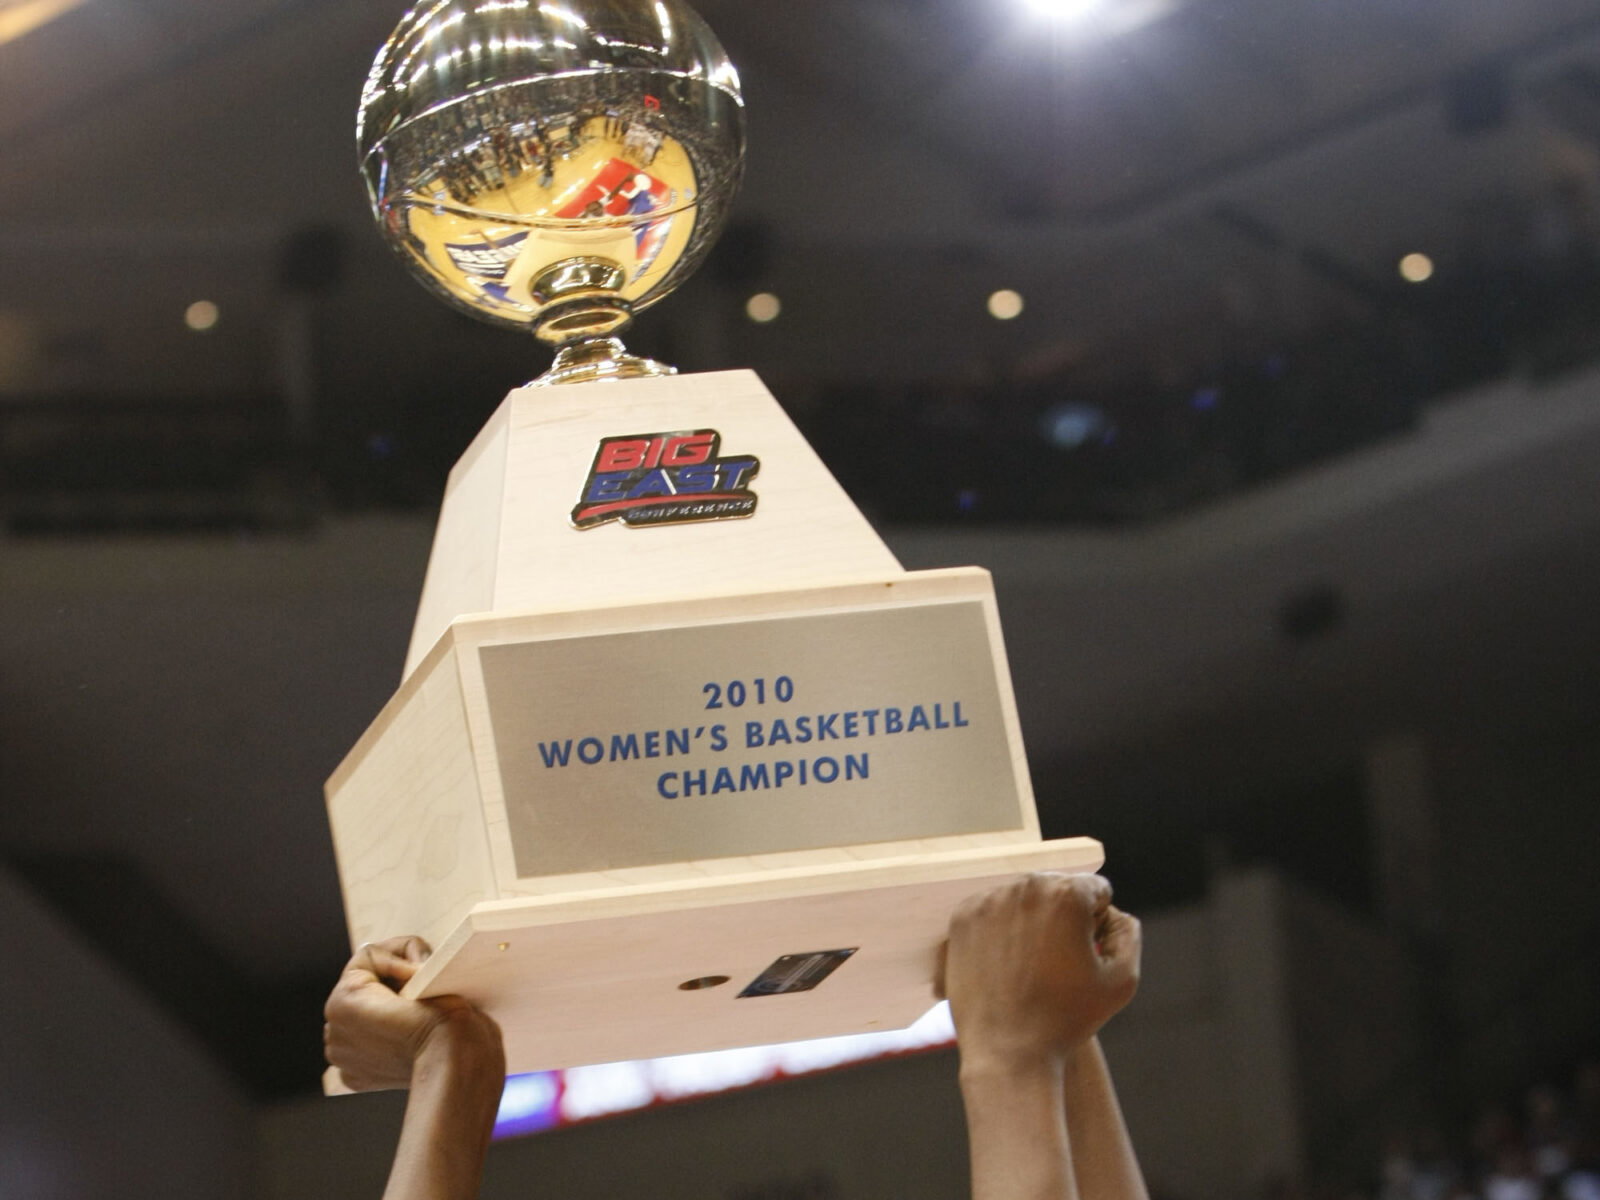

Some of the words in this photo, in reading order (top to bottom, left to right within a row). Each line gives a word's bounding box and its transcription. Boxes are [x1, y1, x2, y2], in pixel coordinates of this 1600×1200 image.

[595, 433, 716, 473] BIG
[587, 460, 757, 503] EAST
[702, 675, 795, 710] 2010
[538, 724, 729, 769] WOMEN'S
[745, 701, 970, 749] BASKETBALL
[656, 752, 871, 800] CHAMPION
